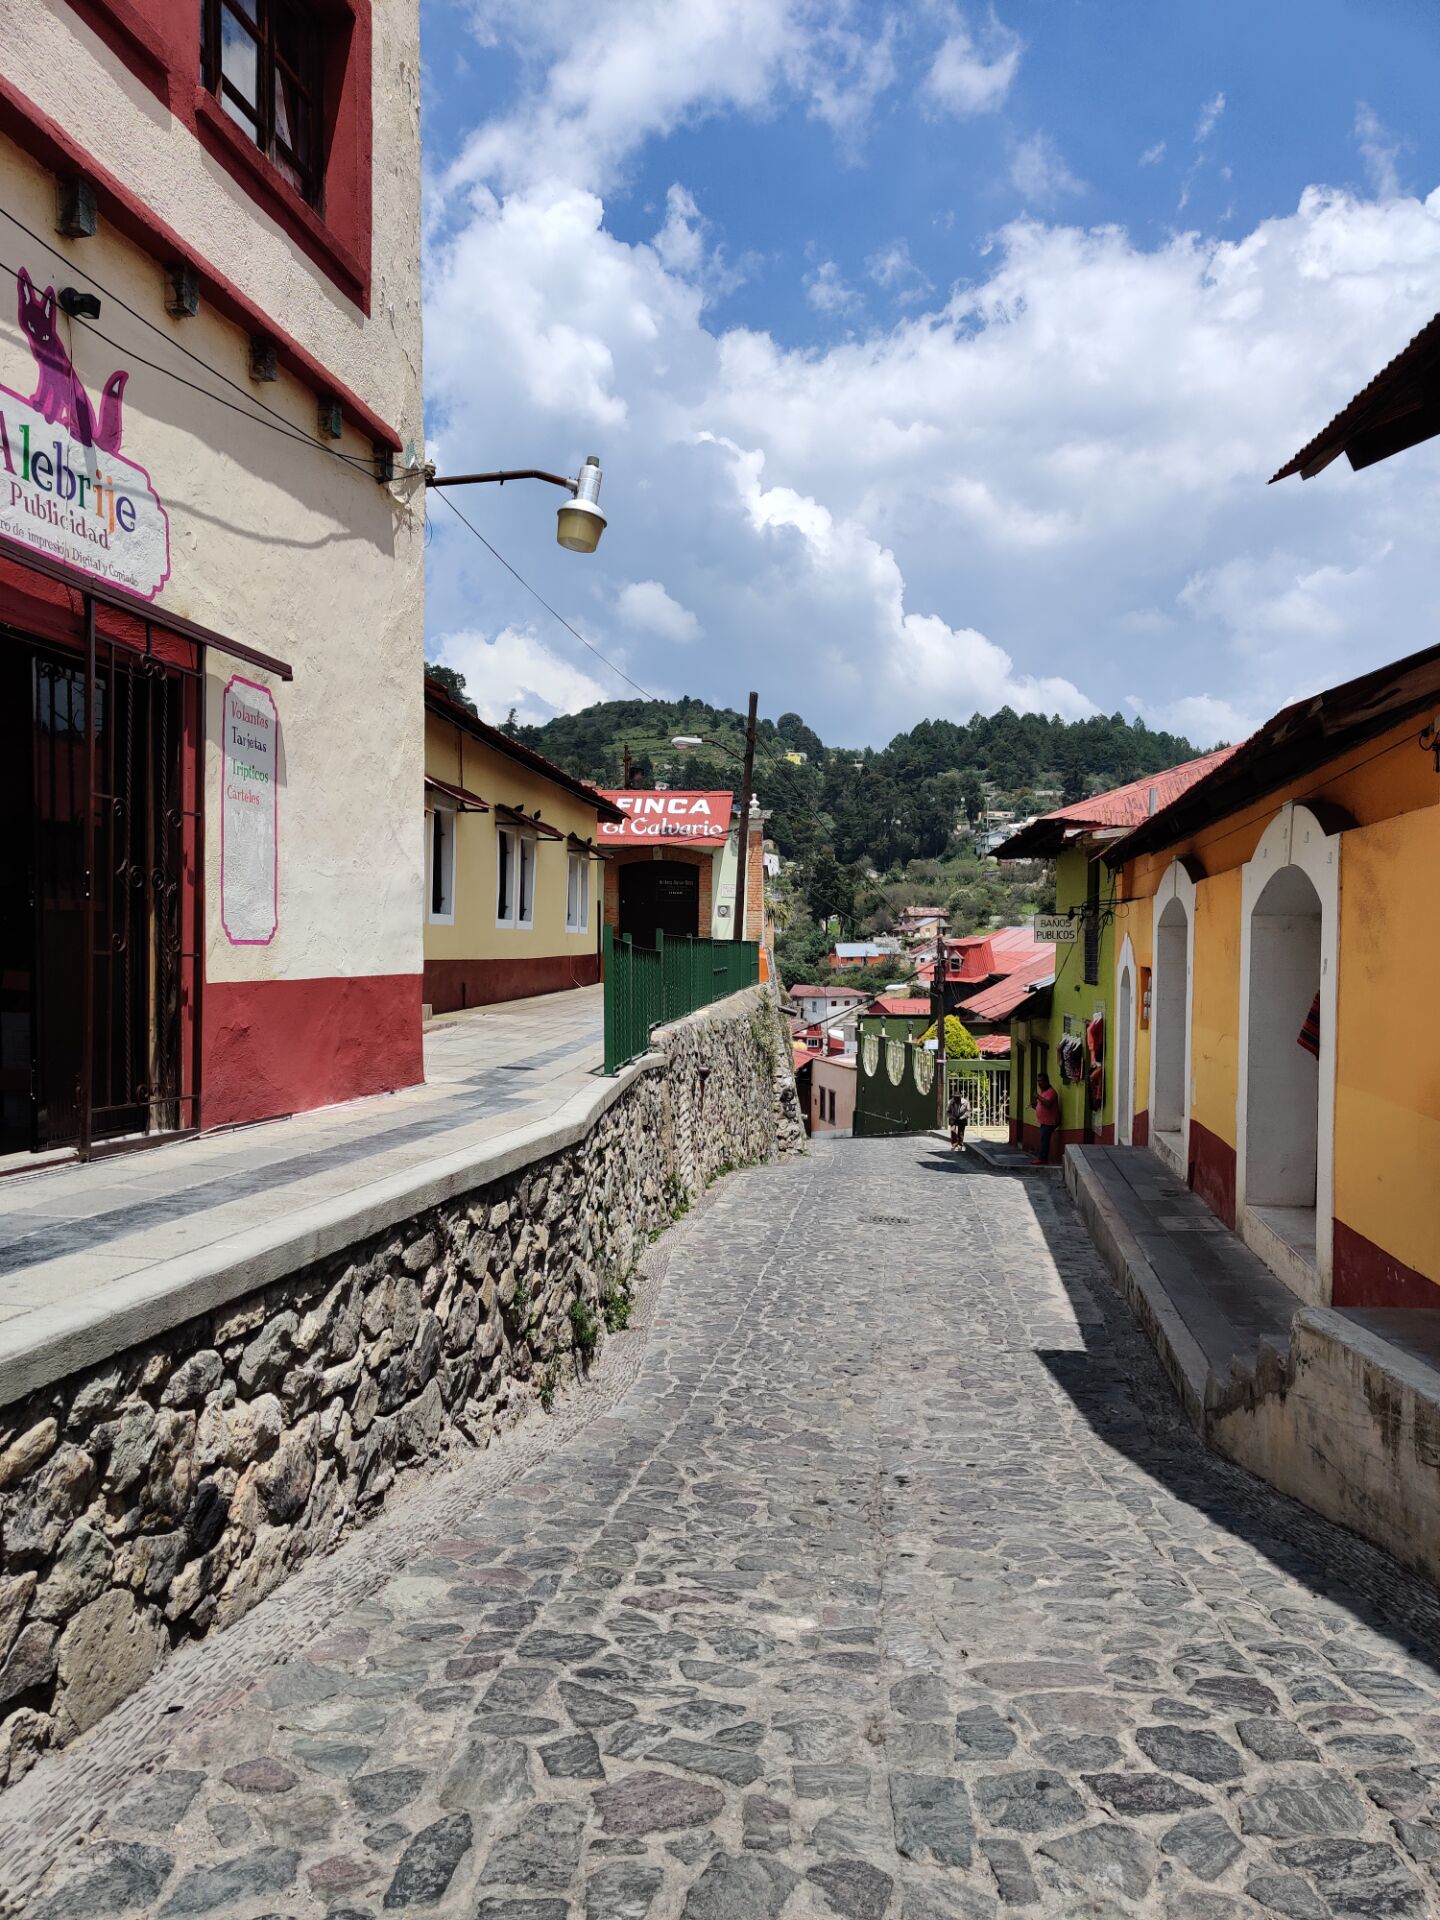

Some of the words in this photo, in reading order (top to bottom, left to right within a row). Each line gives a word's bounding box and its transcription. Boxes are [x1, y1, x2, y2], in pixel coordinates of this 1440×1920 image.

[10, 481, 111, 550] Publicidad
[13, 523, 25, 537] de
[72, 547, 101, 571] Digital
[102, 564, 109, 577] y
[231, 700, 269, 729] Volantes
[232, 726, 267, 753] Tarjetas
[226, 784, 260, 806] Carteles
[615, 798, 711, 815] FINCA
[630, 817, 723, 836] Calvario
